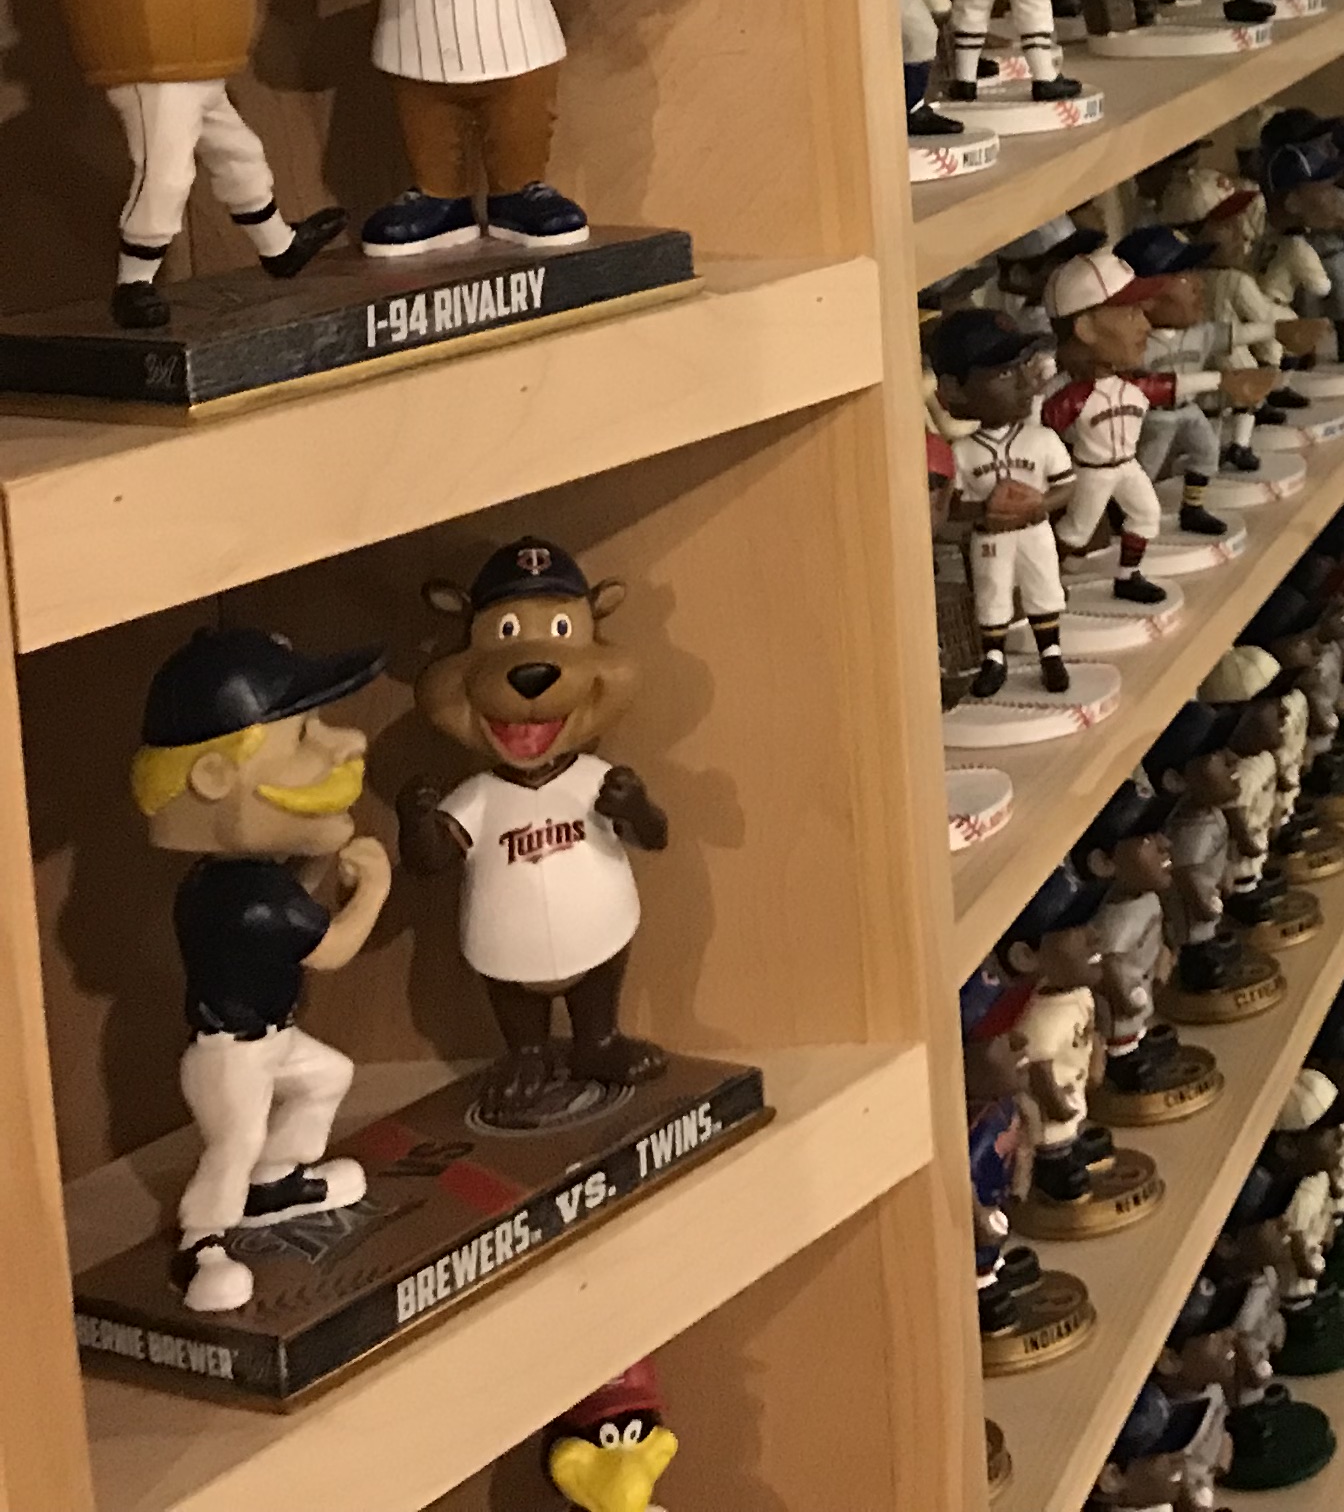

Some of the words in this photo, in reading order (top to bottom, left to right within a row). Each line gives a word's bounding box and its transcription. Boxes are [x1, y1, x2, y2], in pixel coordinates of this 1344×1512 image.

[365, 297, 428, 348] I-94
[435, 267, 545, 331] RIVALRY
[498, 818, 586, 865] Twins
[396, 1209, 530, 1323] BREWERS
[636, 1102, 714, 1178] TWINS
[148, 1331, 235, 1379] BREWER
